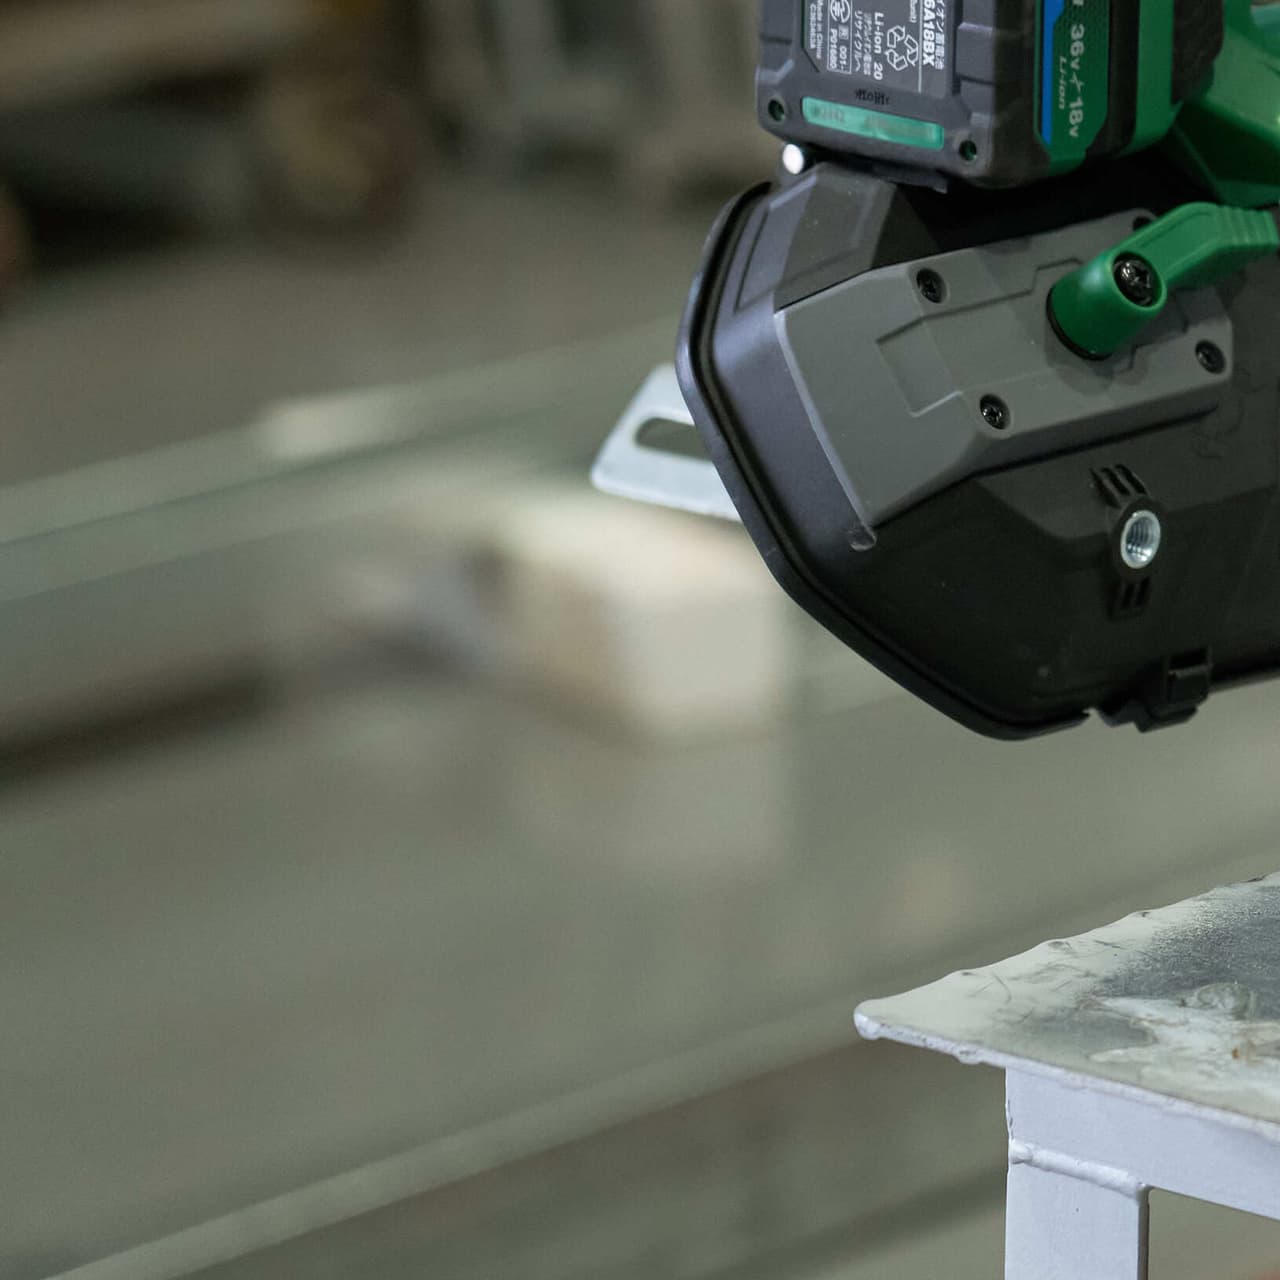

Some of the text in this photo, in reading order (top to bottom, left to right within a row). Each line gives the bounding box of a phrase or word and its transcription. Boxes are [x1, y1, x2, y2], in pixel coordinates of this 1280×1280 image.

[873, 11, 885, 81] Li-ion 20
[1059, 56, 1068, 110] Li-ion
